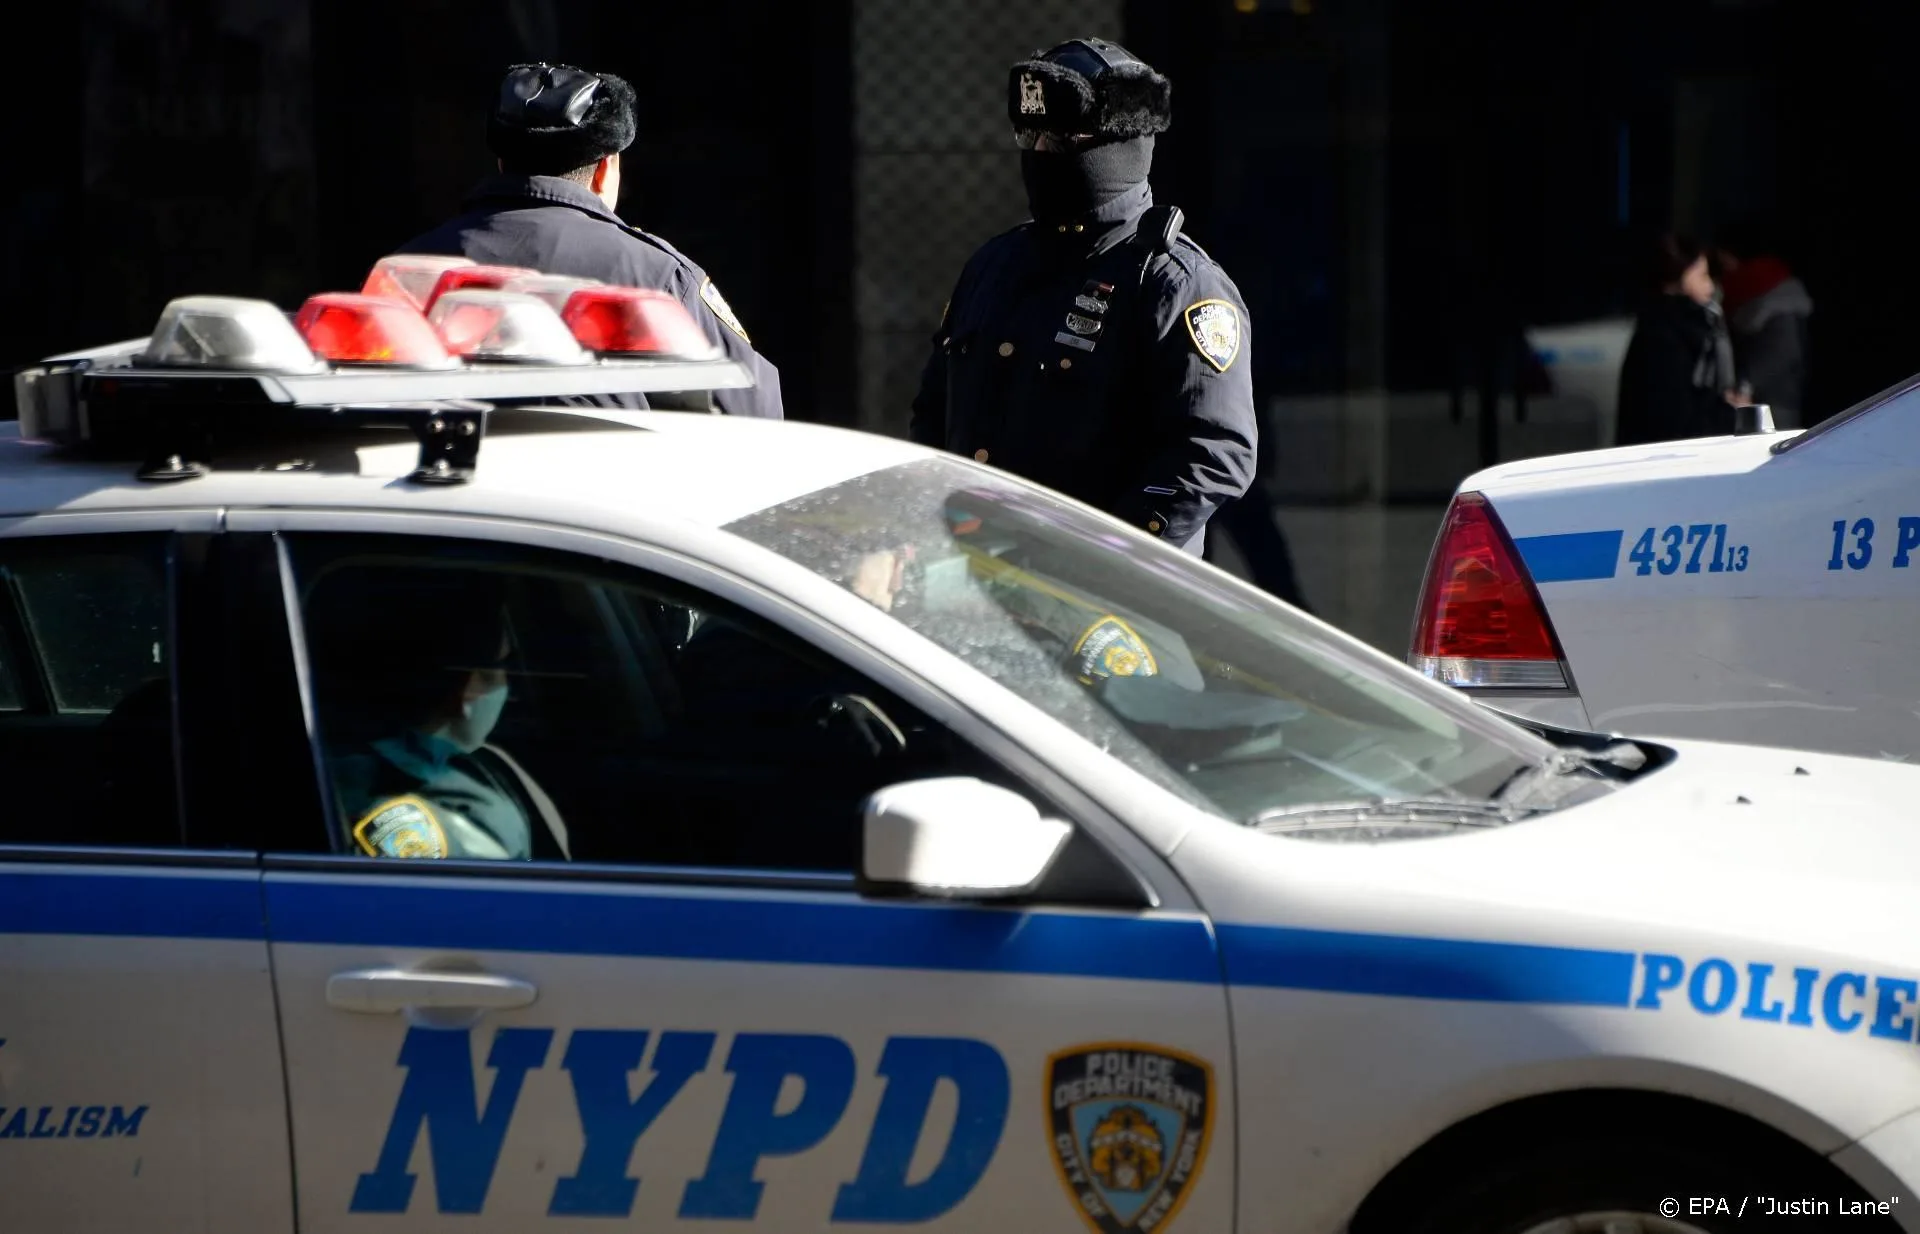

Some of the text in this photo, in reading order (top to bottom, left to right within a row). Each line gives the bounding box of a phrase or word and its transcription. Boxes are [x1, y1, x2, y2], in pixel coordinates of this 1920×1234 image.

[1827, 517, 1875, 571] 13
[1634, 952, 1919, 1044] POLICE
[1085, 1051, 1176, 1079] POLICE
[1054, 1075, 1203, 1117] DEPARTMENT
[0, 1104, 150, 1139] ALISM
[348, 1026, 1012, 1225] NYPD
